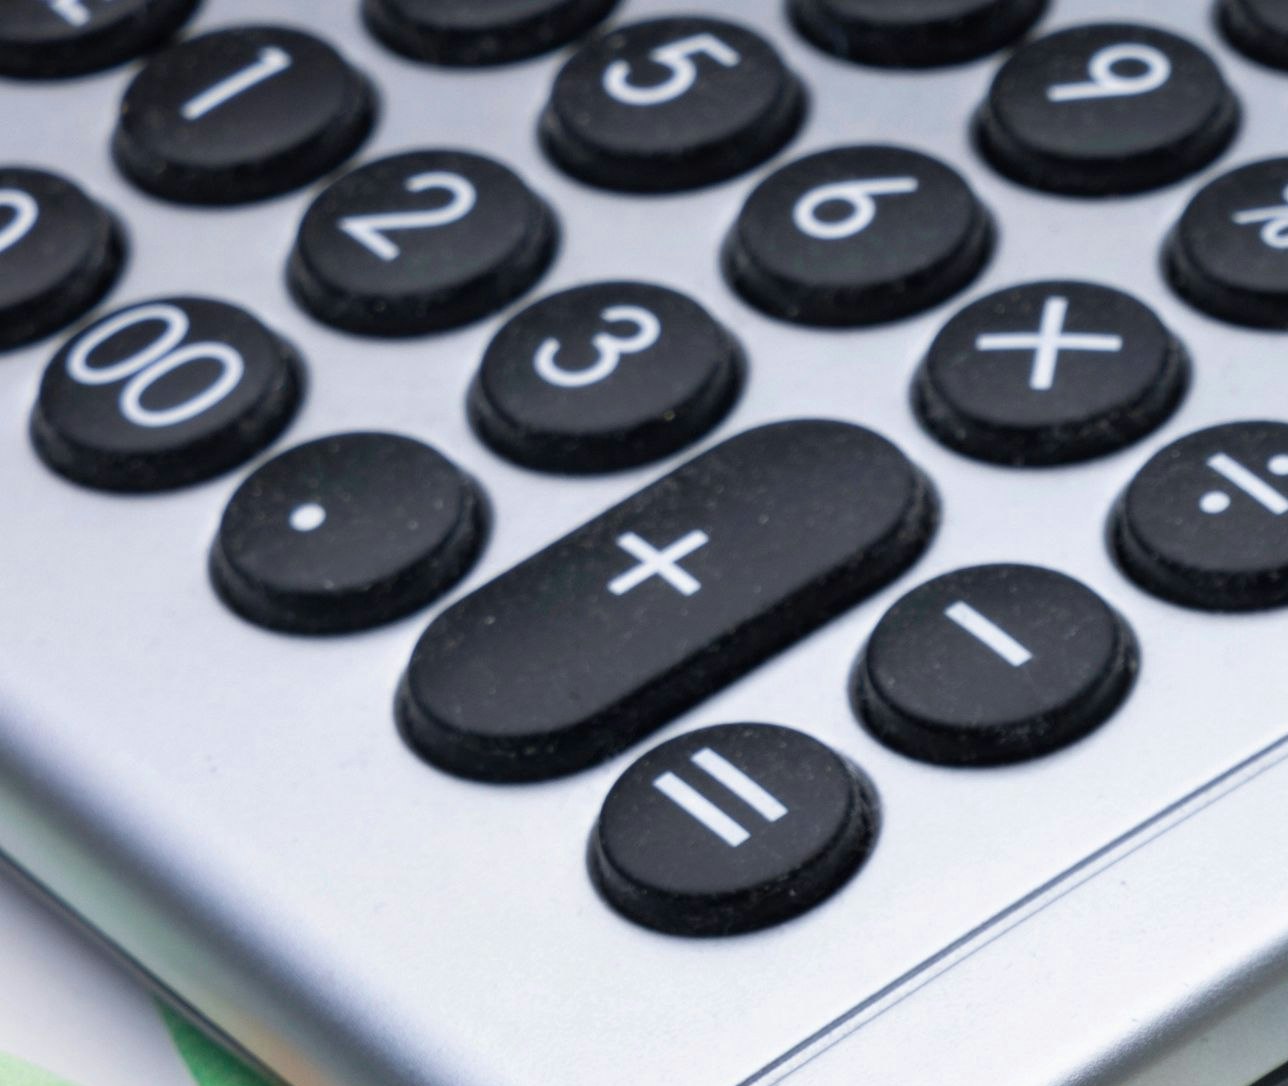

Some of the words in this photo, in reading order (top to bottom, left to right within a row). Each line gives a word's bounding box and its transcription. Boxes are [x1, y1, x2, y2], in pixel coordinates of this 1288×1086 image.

[184, 47, 291, 120] 1
[603, 32, 740, 106] 5
[1046, 42, 1172, 103] 9
[340, 171, 477, 261] 2
[793, 176, 919, 240] 6
[66, 304, 244, 428] 00
[533, 305, 661, 388] 3
